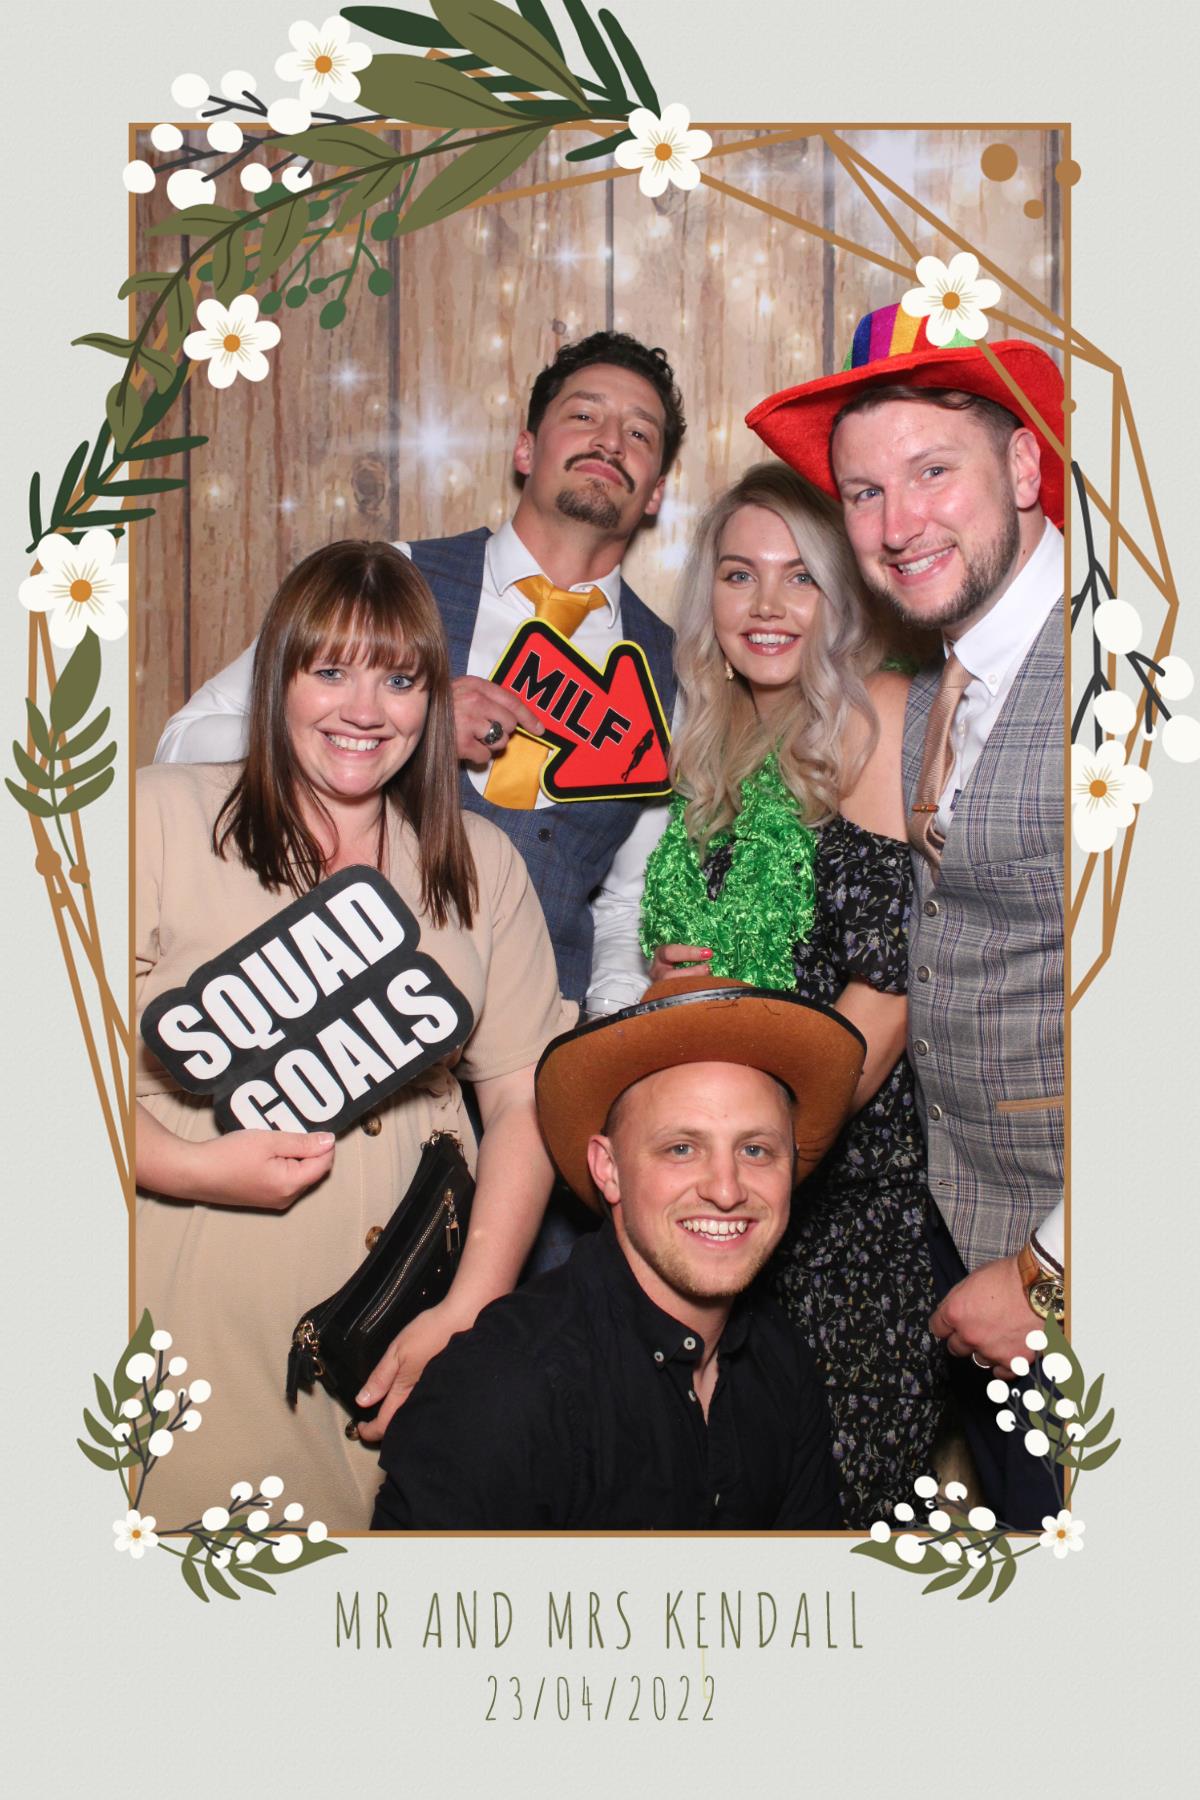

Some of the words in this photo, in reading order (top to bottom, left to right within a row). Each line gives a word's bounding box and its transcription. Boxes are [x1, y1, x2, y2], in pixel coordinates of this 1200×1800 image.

[510, 650, 632, 750] MILF
[158, 882, 406, 1080] SQUAD
[229, 968, 459, 1134] GOALS
